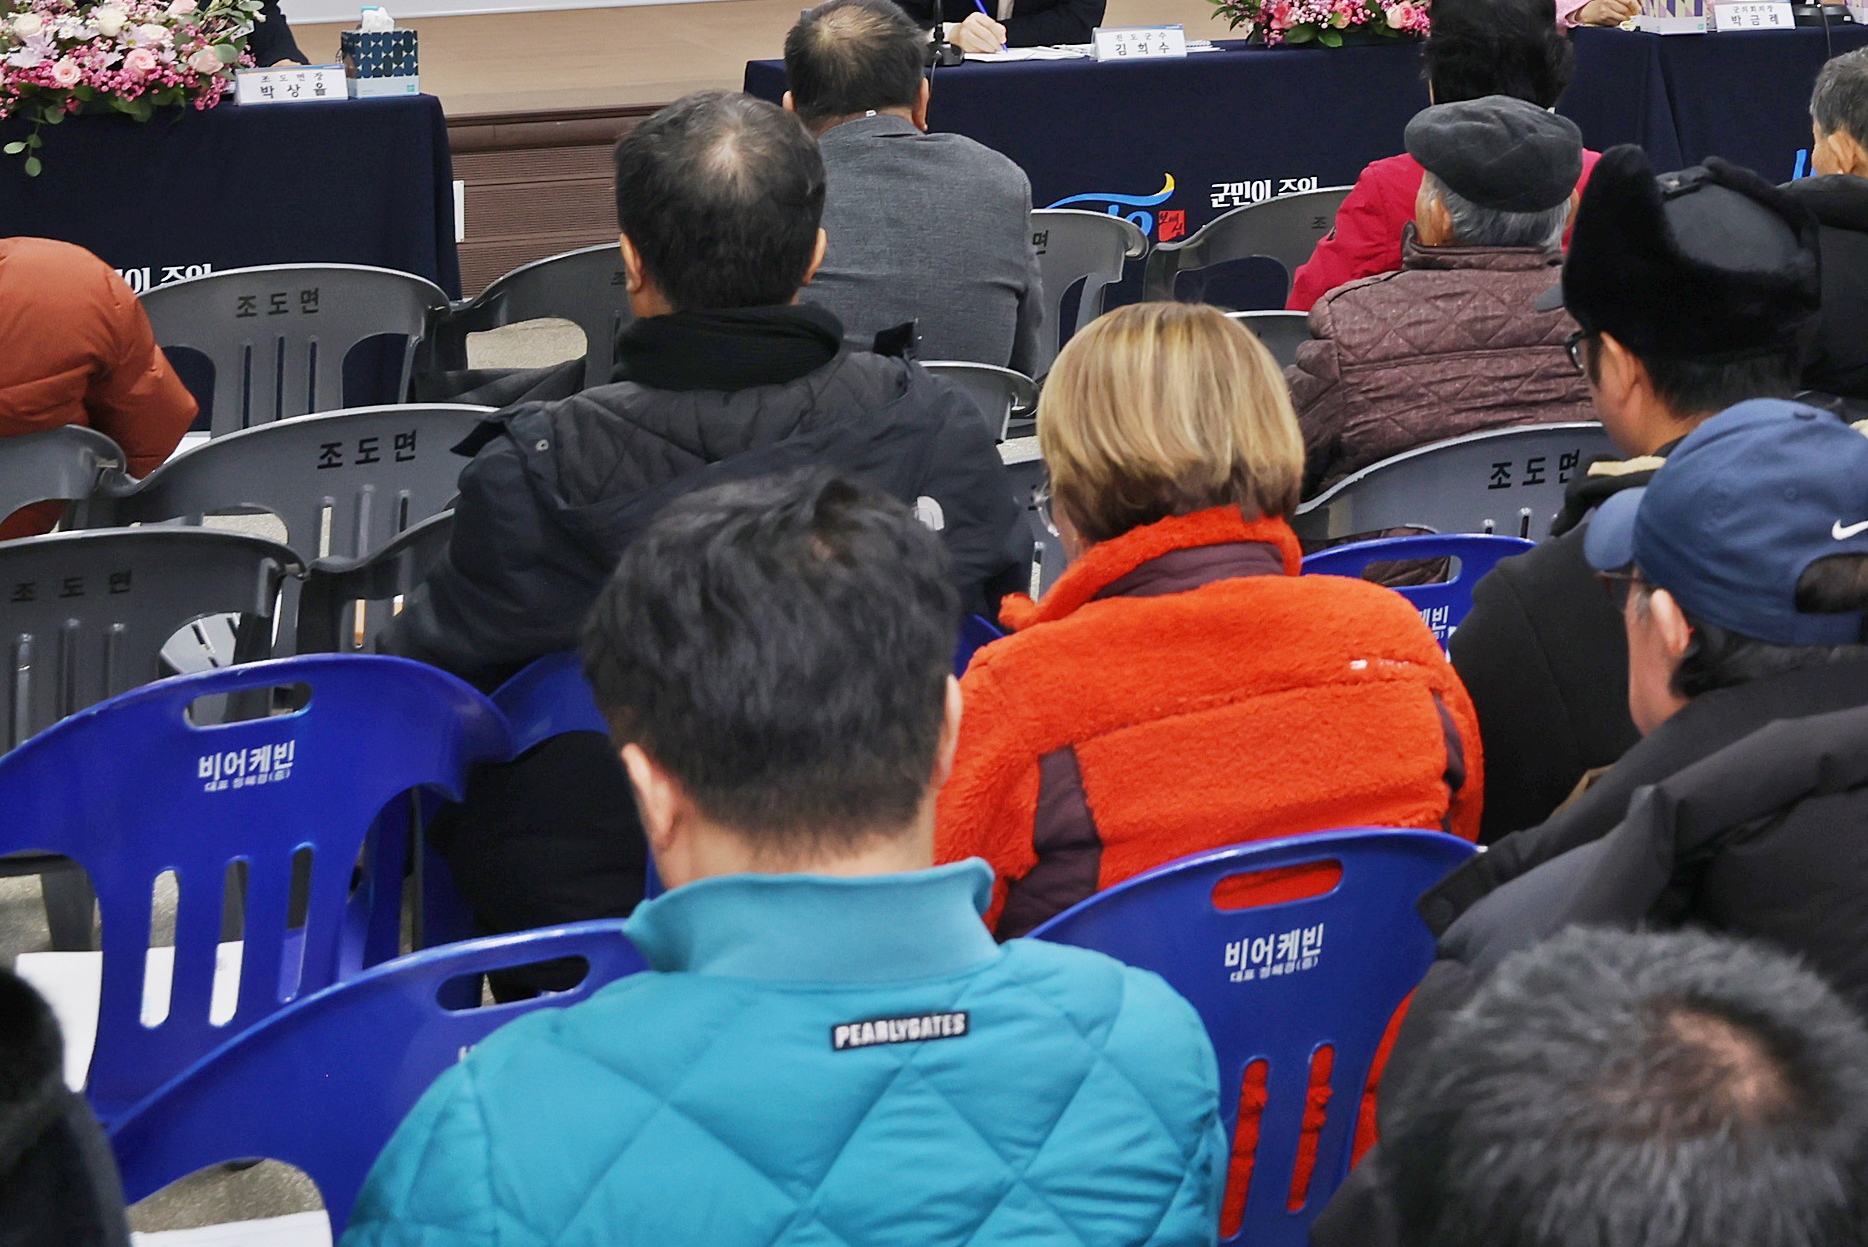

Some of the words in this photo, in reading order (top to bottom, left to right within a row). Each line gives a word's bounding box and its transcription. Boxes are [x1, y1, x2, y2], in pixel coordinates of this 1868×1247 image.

[1210, 179, 1272, 208] 군민이
[236, 287, 320, 318] 조도면
[317, 429, 418, 470] 조도면
[1488, 449, 1580, 489] 조도면
[199, 740, 295, 781] 비어케빈
[1225, 922, 1324, 970] 비어케빈
[835, 1013, 965, 1049] PEARLYGATES
